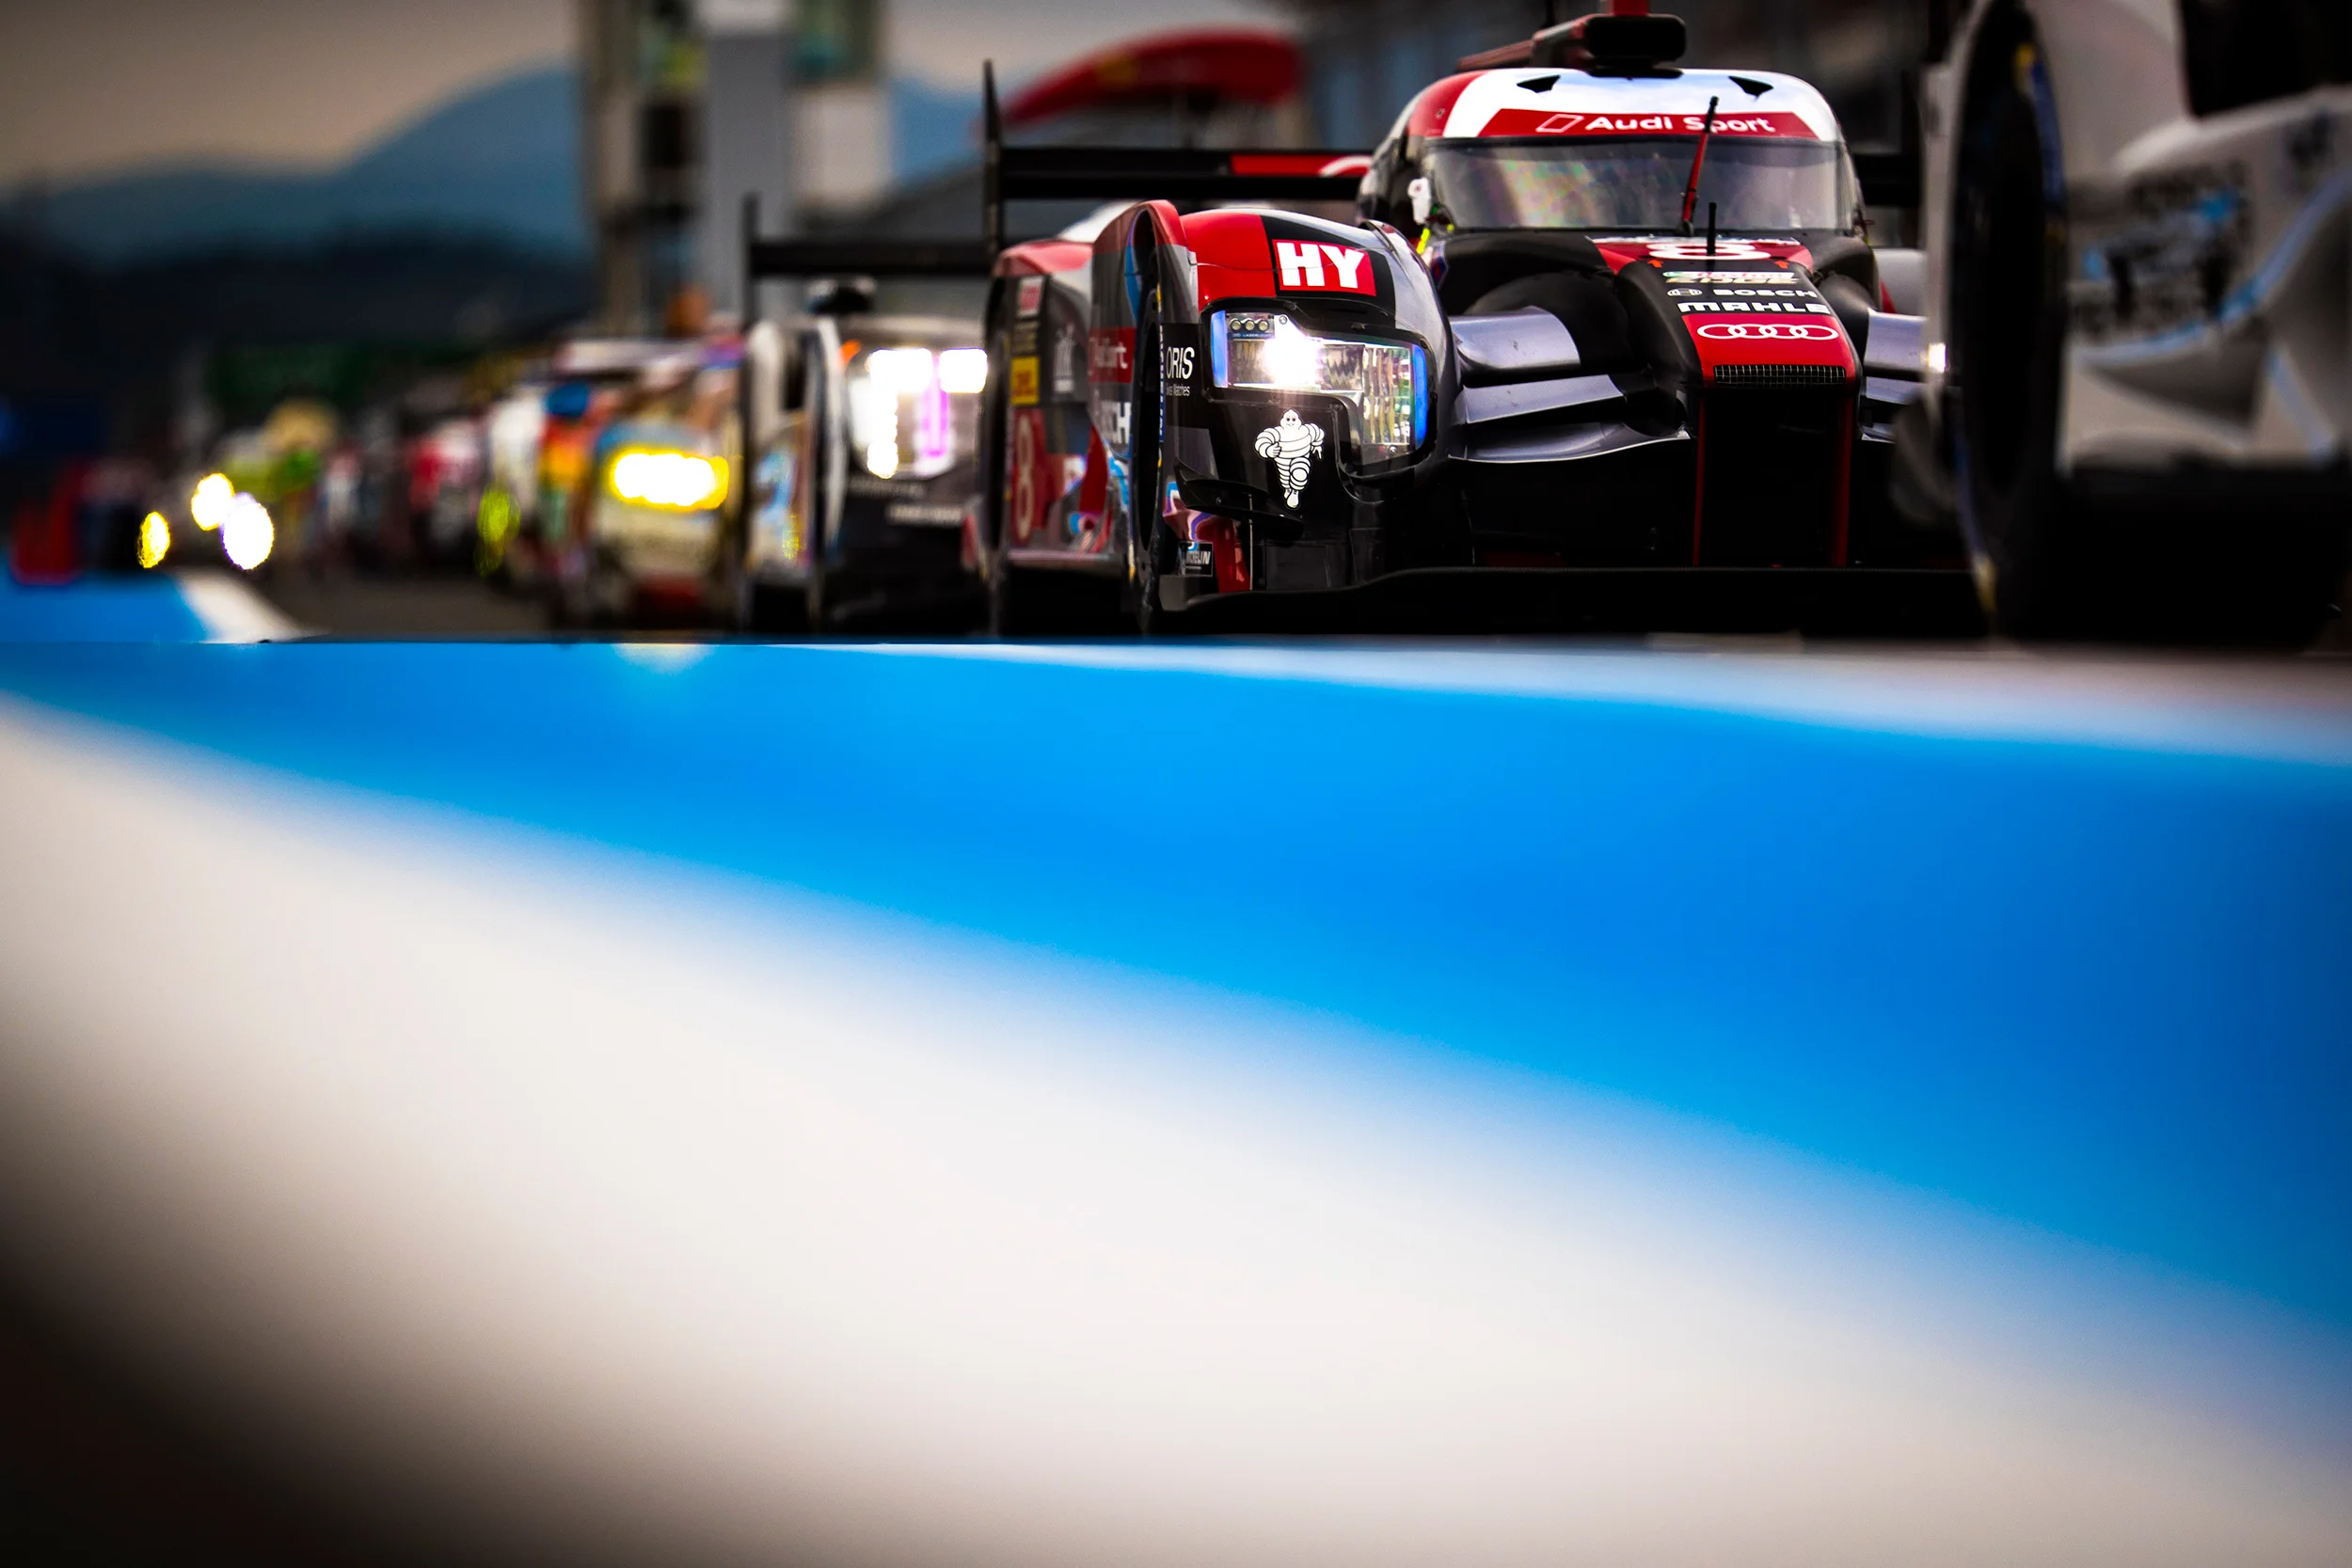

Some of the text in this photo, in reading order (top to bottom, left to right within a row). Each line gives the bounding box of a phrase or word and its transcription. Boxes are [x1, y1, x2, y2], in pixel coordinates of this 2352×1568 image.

[1585, 116, 1776, 134] Audi Sport
[1276, 242, 1365, 289] HY
[1712, 289, 1818, 297] BOSCH
[1677, 302, 1831, 314] MAHLE
[1166, 346, 1195, 379] ORIS
